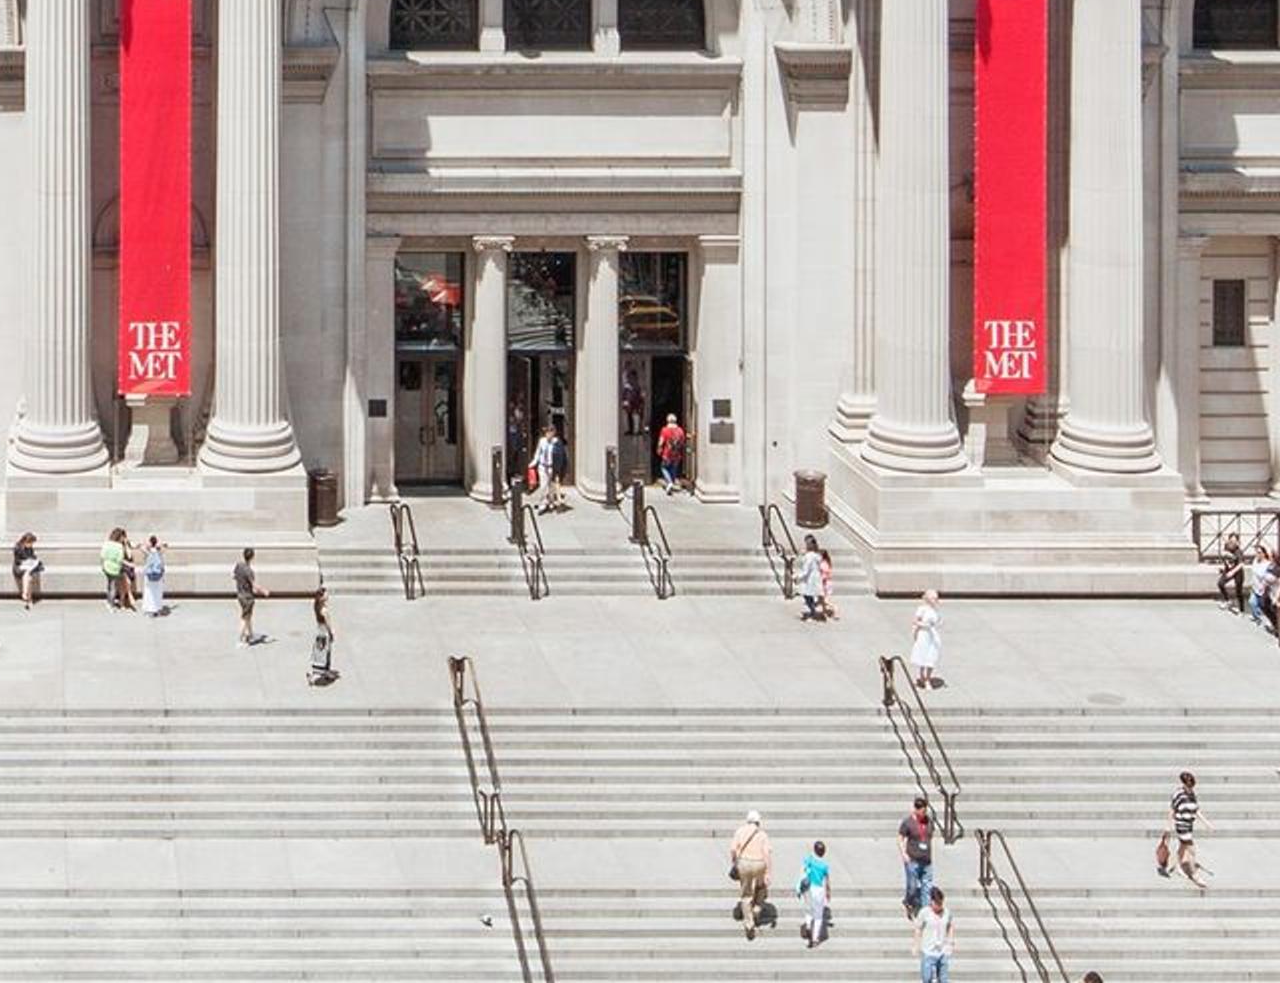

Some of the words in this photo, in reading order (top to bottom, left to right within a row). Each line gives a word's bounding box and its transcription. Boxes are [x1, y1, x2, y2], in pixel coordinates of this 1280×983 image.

[128, 321, 181, 349] THE
[984, 320, 1036, 349] THE
[128, 351, 183, 378] MET
[984, 350, 1037, 378] MET
